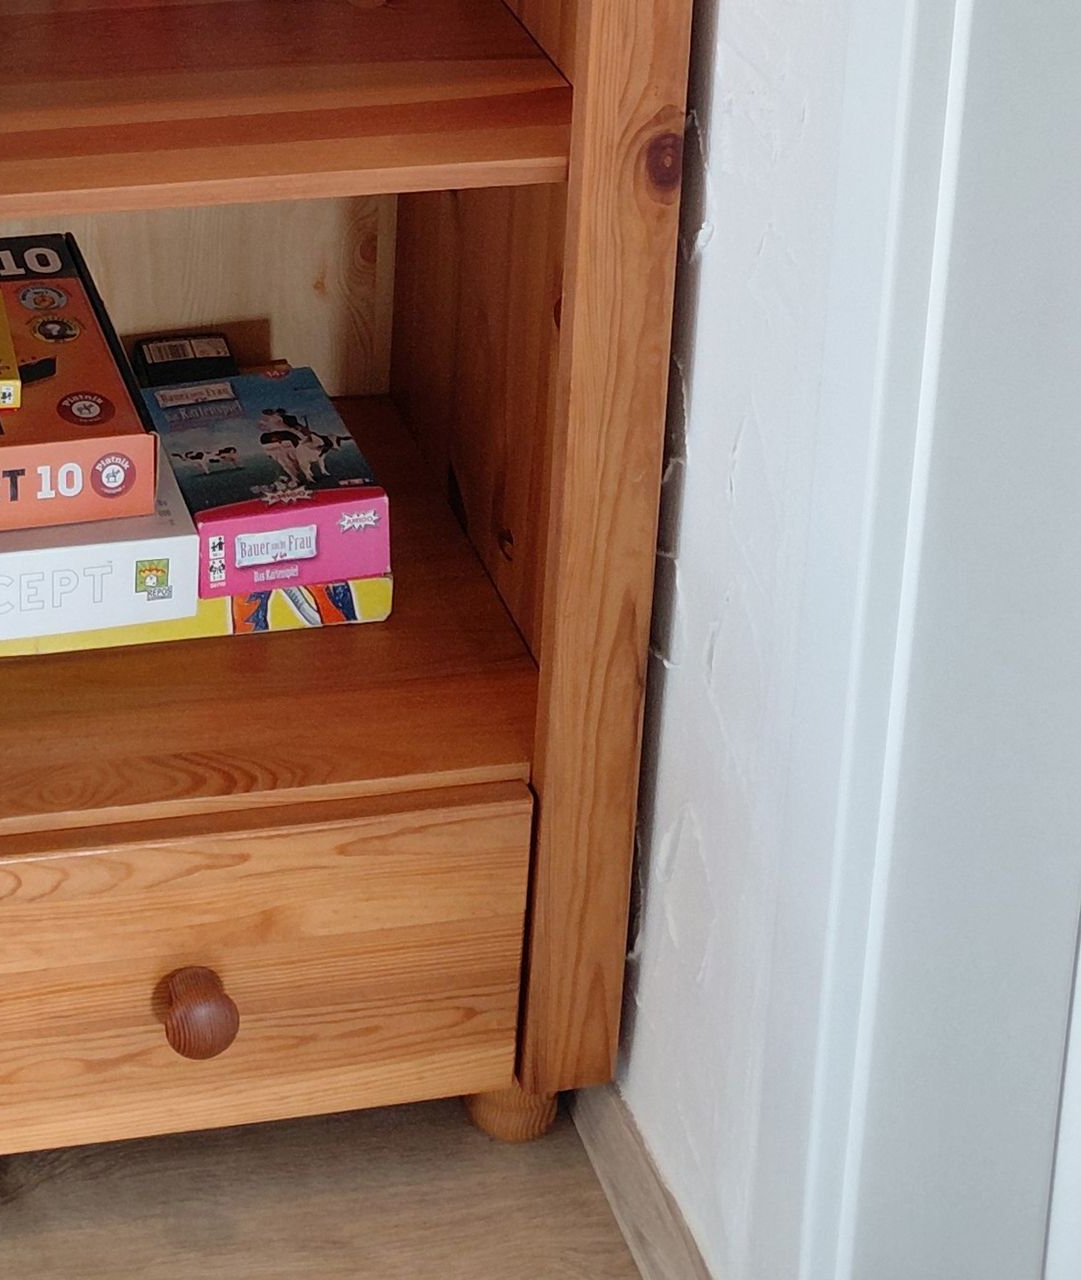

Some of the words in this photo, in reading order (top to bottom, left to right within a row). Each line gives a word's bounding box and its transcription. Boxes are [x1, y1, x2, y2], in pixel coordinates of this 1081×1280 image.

[62, 394, 104, 407] Platnik
[95, 455, 131, 473] Platnik
[35, 462, 84, 501] 10
[239, 541, 270, 559] Bauer
[287, 534, 313, 552] Frau
